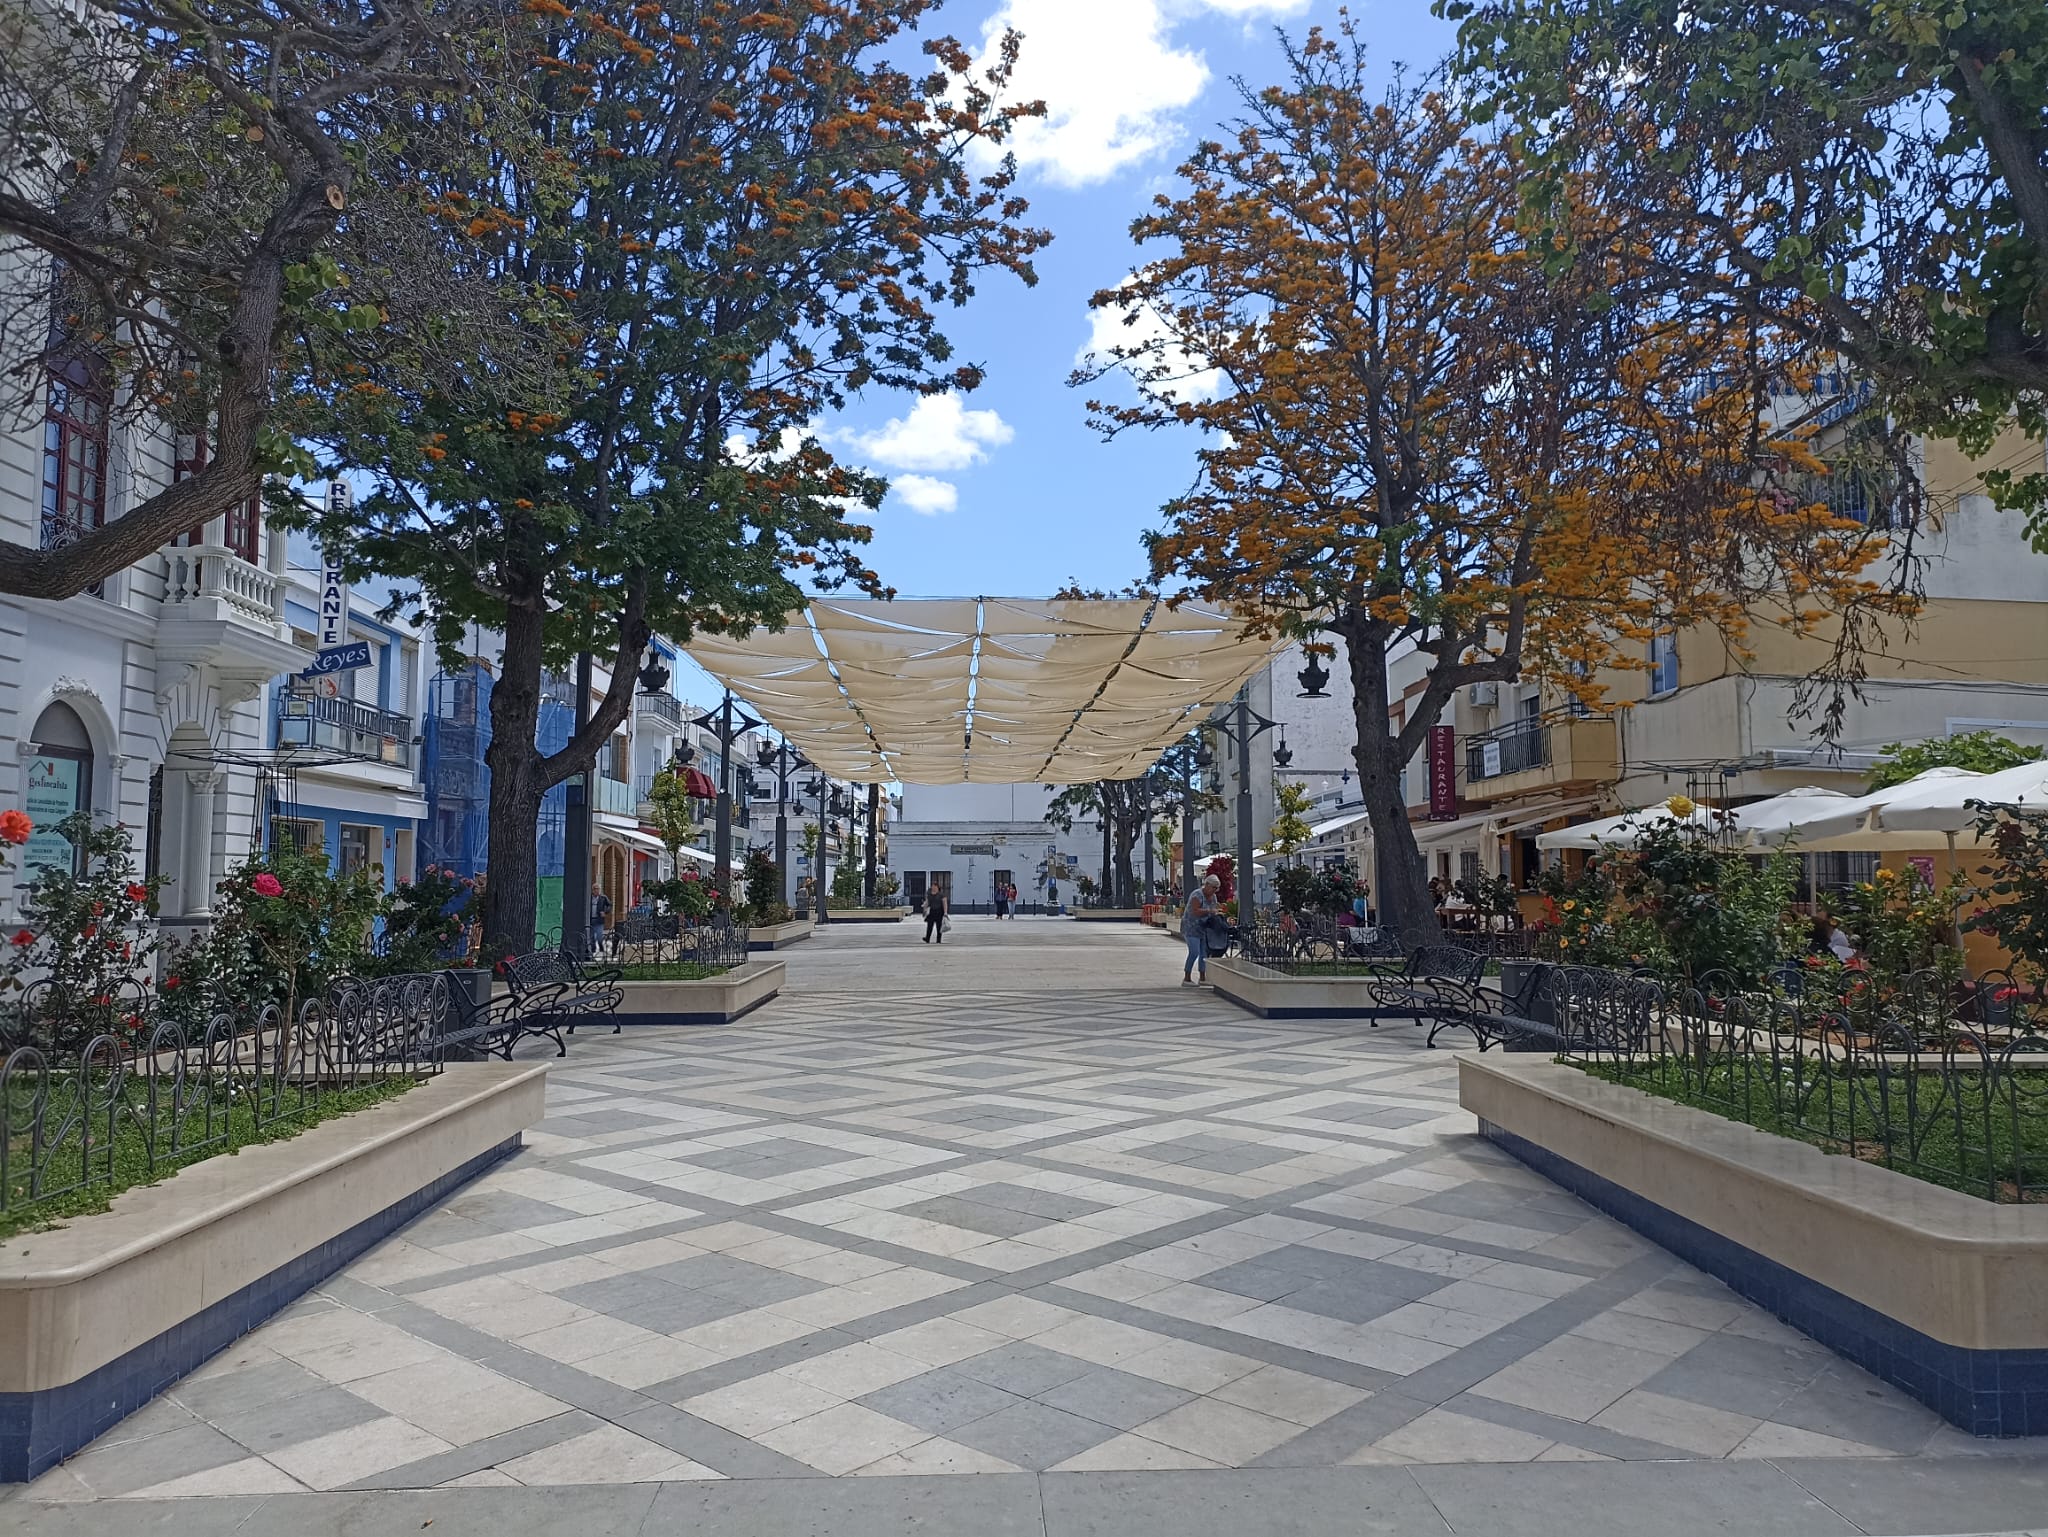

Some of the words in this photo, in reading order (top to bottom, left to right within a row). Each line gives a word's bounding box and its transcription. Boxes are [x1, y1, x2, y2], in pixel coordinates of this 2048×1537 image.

[323, 483, 346, 644] REURANTE
[308, 648, 367, 672] Reyes
[1437, 727, 1447, 811] RESTAURANTE
